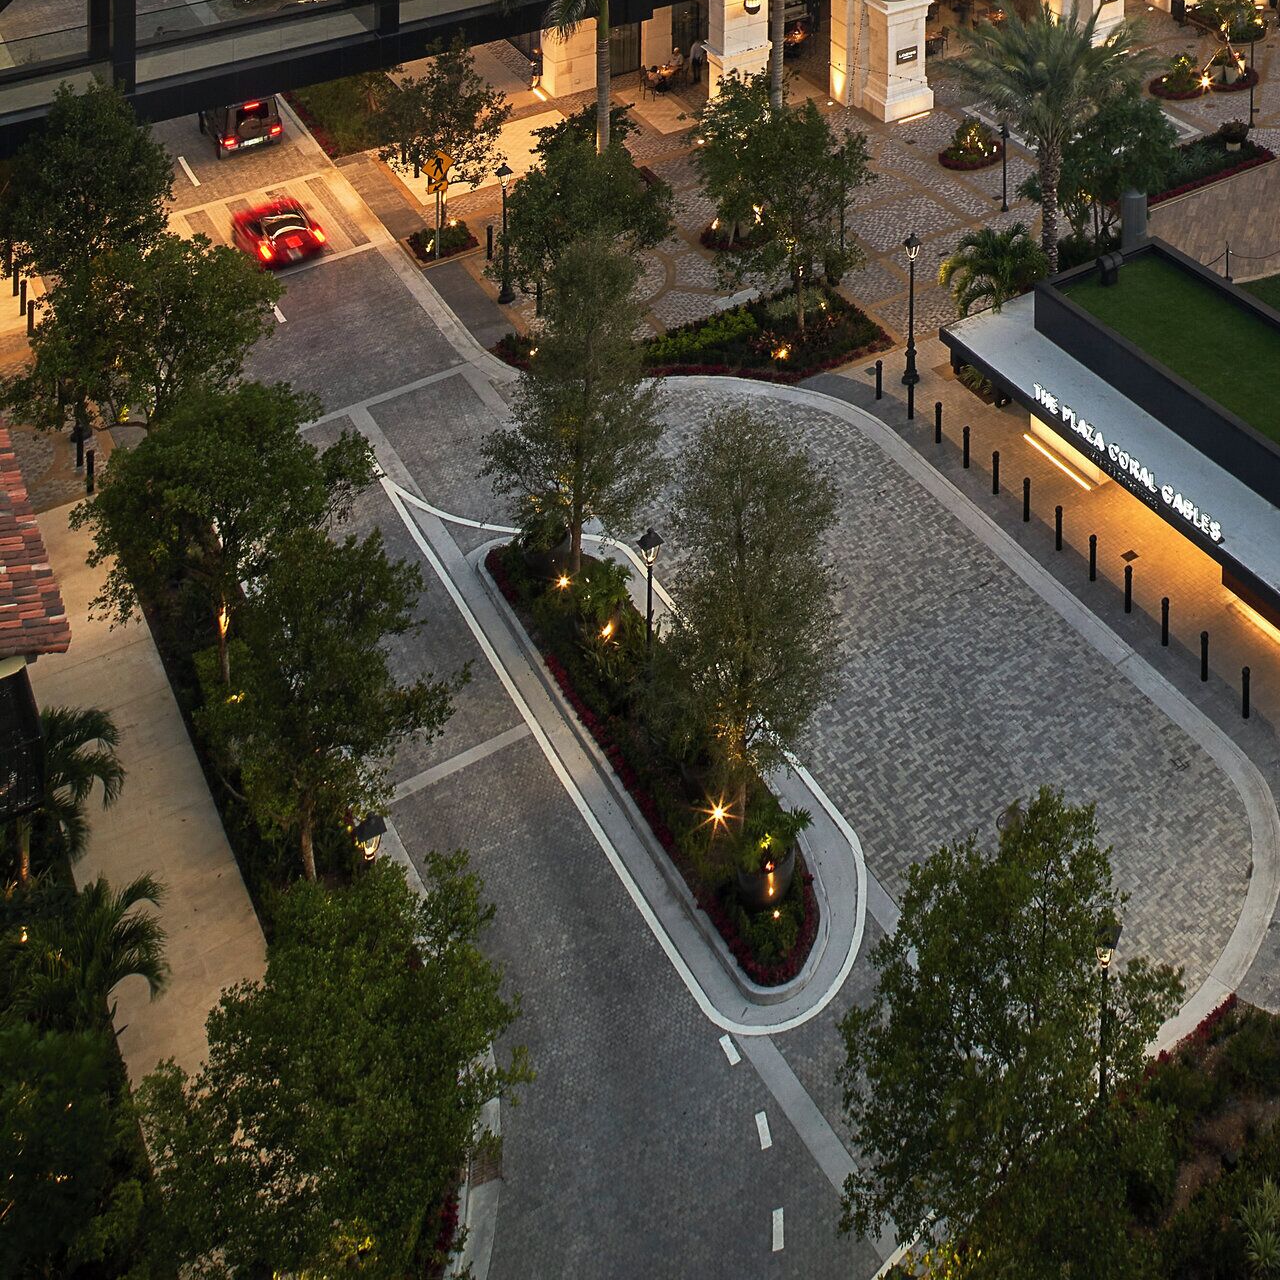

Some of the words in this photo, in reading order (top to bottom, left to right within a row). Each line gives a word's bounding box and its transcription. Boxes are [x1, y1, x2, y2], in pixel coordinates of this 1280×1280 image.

[1033, 382, 1059, 415] THE
[1062, 405, 1105, 451] PLAZA
[1108, 443, 1157, 493] CORAL
[1161, 485, 1222, 541] GABLES
